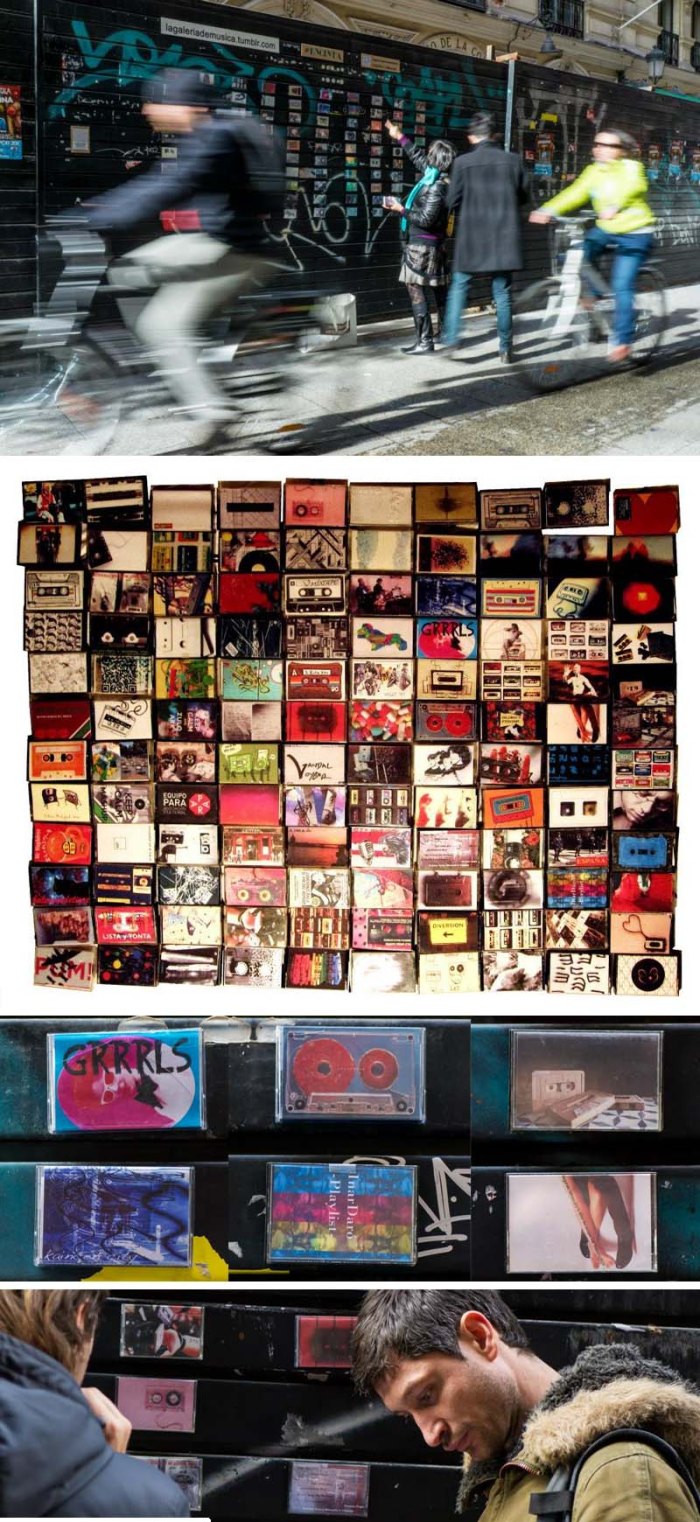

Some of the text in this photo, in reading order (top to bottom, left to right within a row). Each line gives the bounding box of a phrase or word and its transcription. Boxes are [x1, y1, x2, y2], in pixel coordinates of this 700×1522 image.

[165, 23, 276, 50] lagaleriademusica.tumblr.com
[440, 37, 452, 48] DE
[456, 39, 467, 51] LA
[421, 622, 475, 637] GRRRLS
[163, 799, 187, 807] PARA
[63, 1038, 192, 1076] GRRRLS
